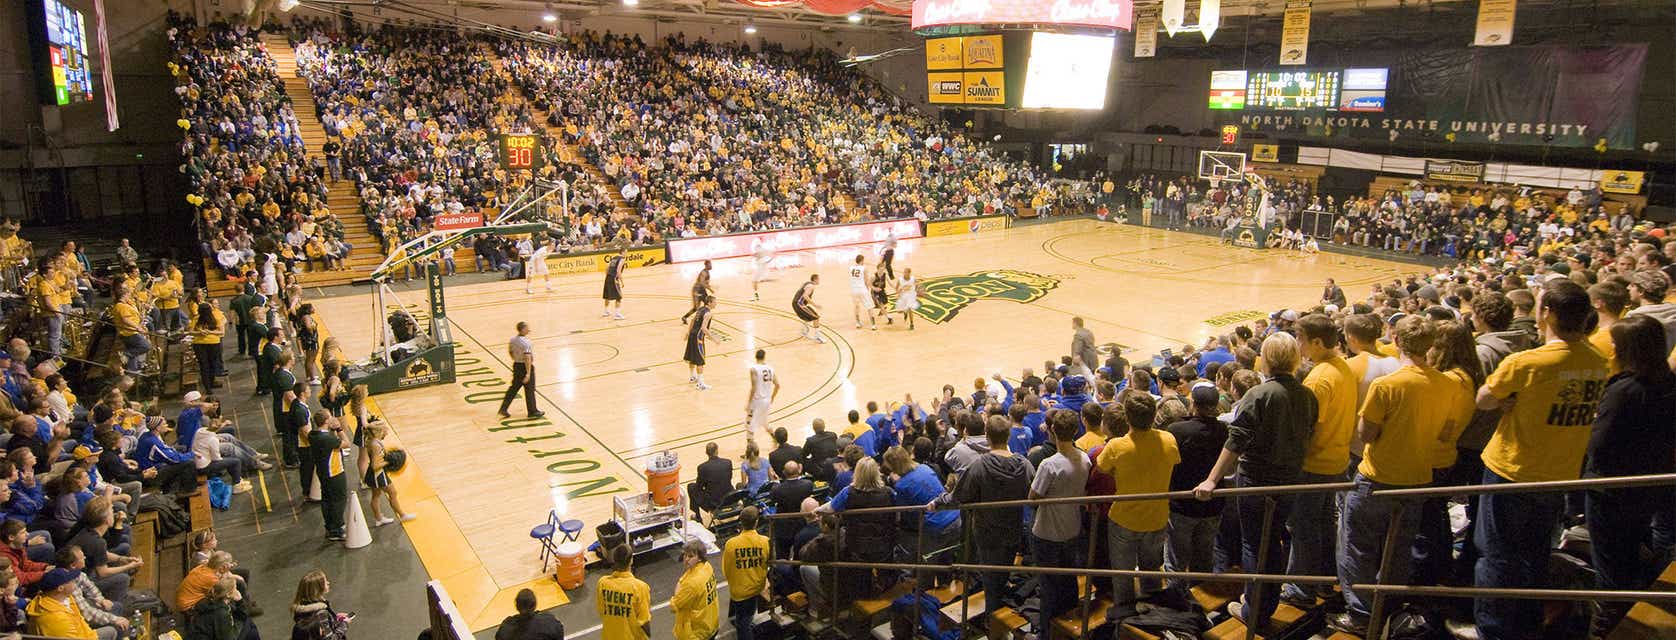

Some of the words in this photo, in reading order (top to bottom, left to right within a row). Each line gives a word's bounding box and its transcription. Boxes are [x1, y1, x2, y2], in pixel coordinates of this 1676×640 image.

[1278, 72, 1307, 83] 10:02
[967, 87, 1000, 97] SUMMIT
[1271, 87, 1282, 96] 10
[1301, 87, 1312, 97] 15
[1241, 115, 1293, 126] NORTH
[1302, 116, 1370, 128] DAKOTA
[1382, 118, 1439, 130] STATE
[1451, 120, 1588, 137] UNIVERSITY
[507, 136, 534, 148] 10:02
[509, 148, 532, 167] 30
[559, 261, 576, 272] City
[575, 258, 596, 267] Bank
[762, 369, 772, 382] 21
[487, 415, 629, 501] North
[735, 547, 764, 559] EVENT
[735, 558, 764, 570] STAFF
